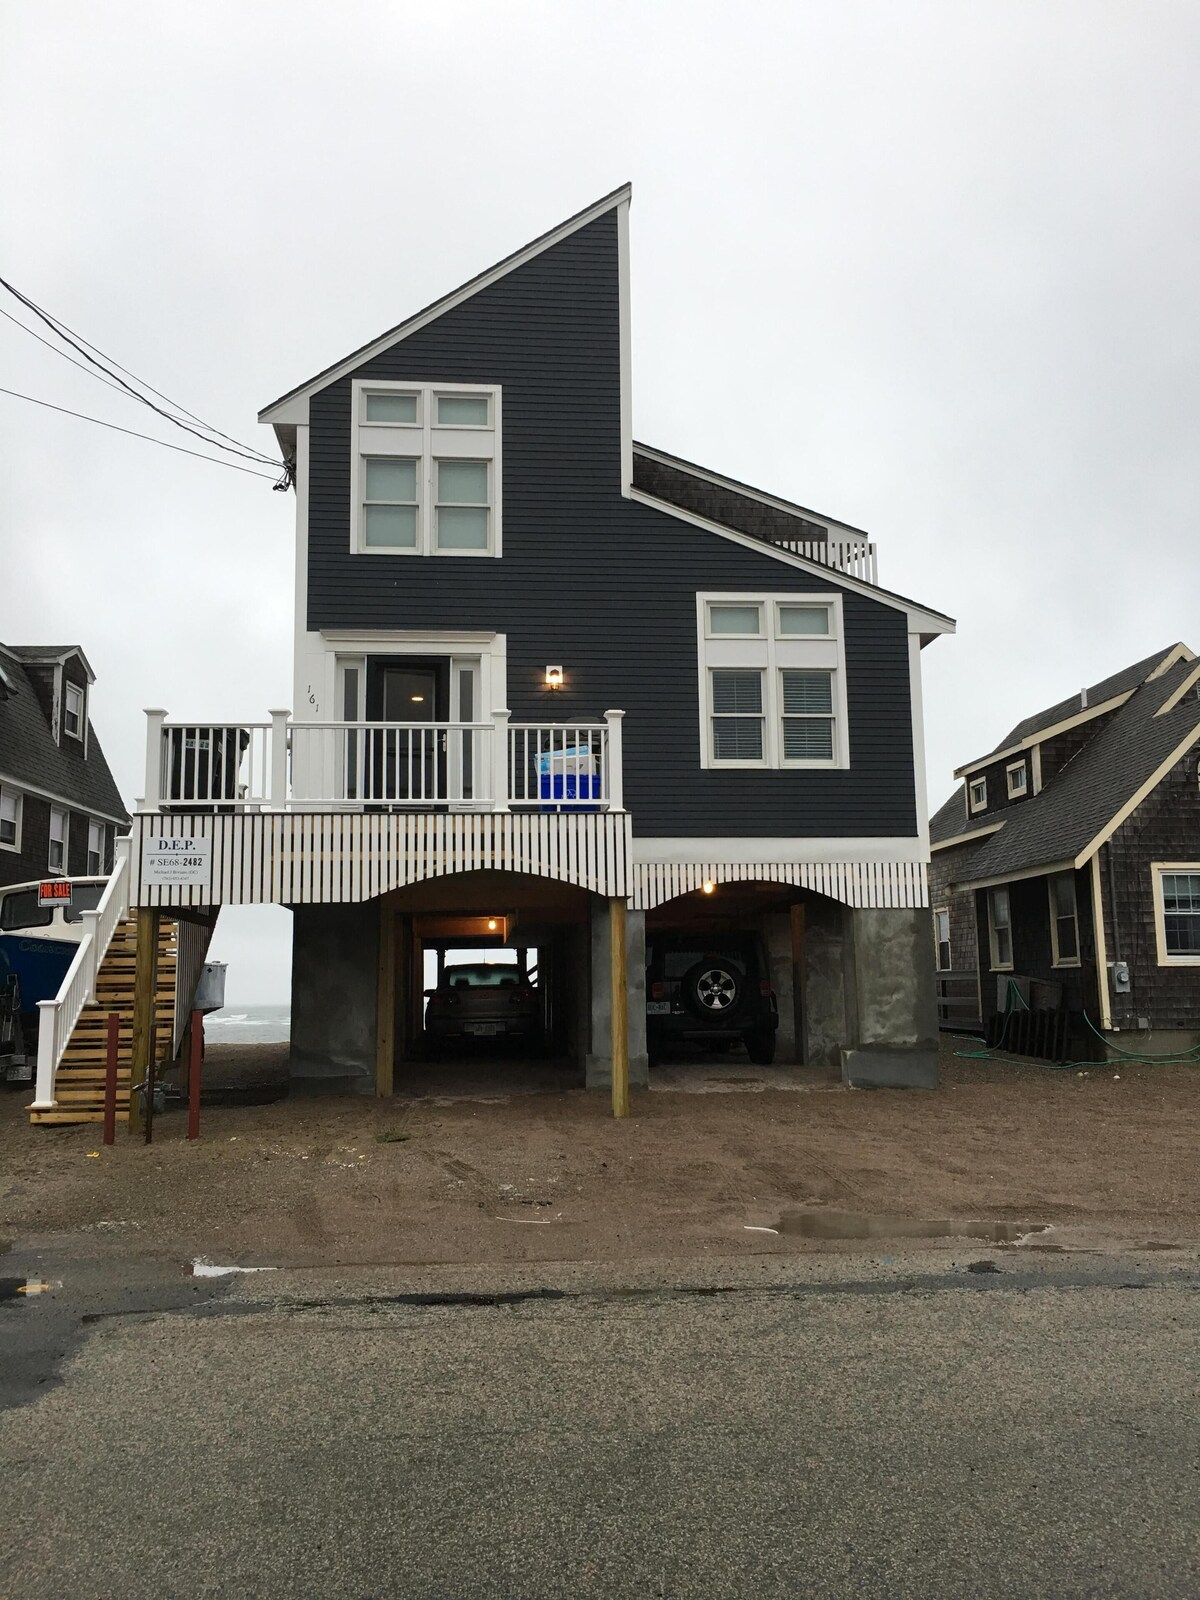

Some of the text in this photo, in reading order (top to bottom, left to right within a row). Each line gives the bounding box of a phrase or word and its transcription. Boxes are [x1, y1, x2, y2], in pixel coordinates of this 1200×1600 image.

[307, 684, 320, 713] 161
[158, 839, 196, 850] D.E.P.
[157, 857, 203, 867] SE68-2482
[40, 883, 70, 898] FOR SALE
